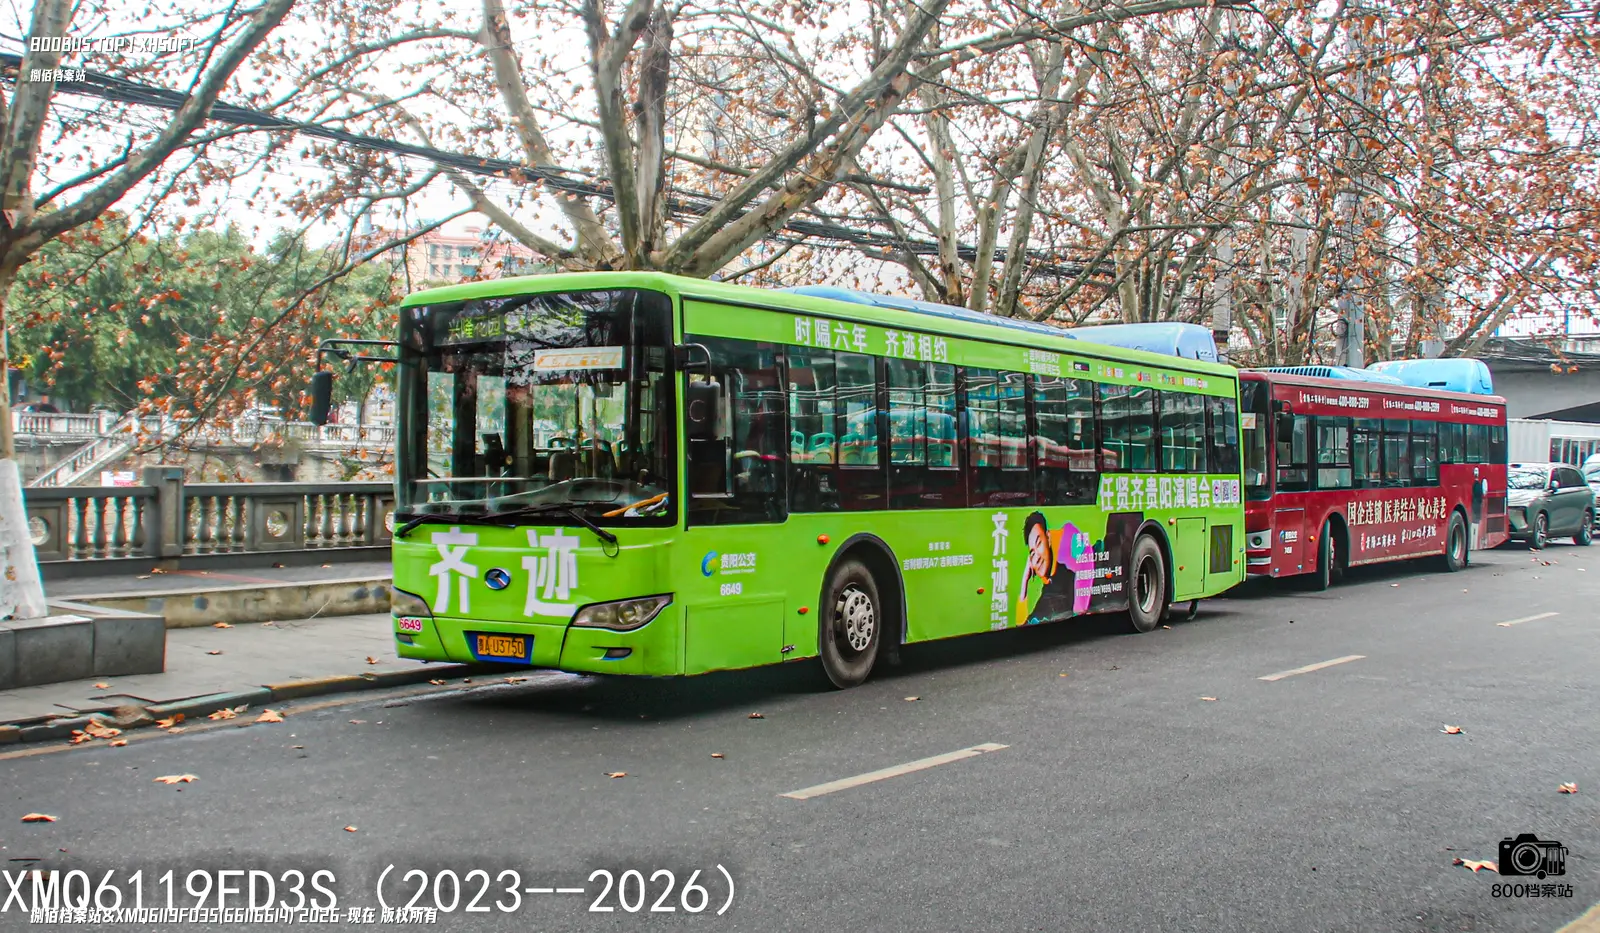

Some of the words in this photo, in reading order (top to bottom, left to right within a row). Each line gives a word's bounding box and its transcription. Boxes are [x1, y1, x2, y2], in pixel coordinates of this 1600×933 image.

[794, 316, 868, 352] 时隔六年
[884, 329, 948, 363] 齐迹相约
[1100, 475, 1210, 512] 任贤齐贵阳演唱会
[1347, 501, 1383, 527] 国企连锁
[1384, 498, 1416, 524] 医养结合
[429, 527, 580, 618] 齐迹
[721, 552, 756, 569] 贵阳公交
[991, 511, 1008, 601] 齐迹
[720, 582, 742, 596] 6649
[399, 618, 422, 631] 6649
